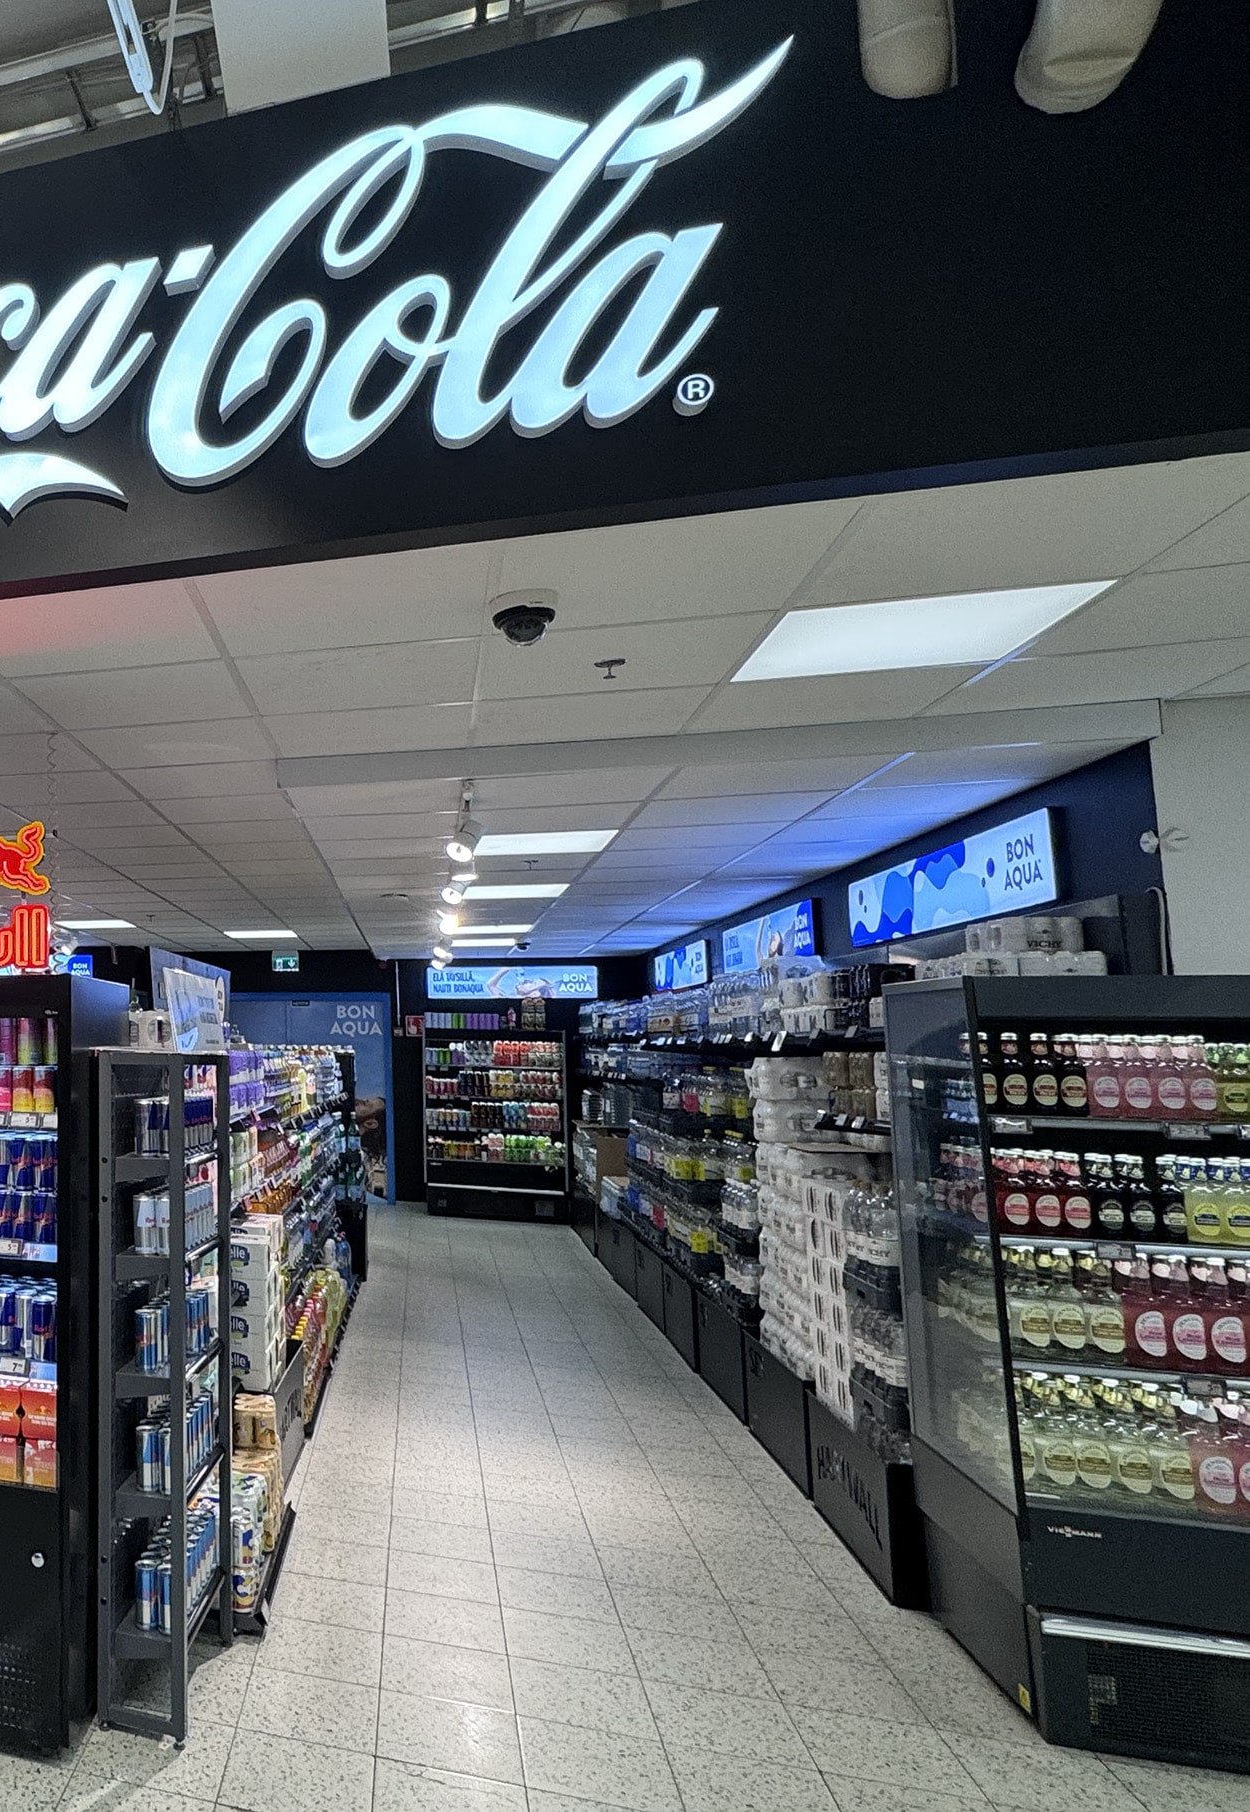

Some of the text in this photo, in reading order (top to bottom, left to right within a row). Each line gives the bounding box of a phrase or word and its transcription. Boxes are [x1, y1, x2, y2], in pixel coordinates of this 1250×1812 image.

[1006, 833, 1035, 862] BON
[1004, 861, 1043, 890] AQUA
[1026, 939, 1063, 949] VICHY
[562, 973, 588, 982] BON
[558, 983, 593, 992] AQUA
[336, 1005, 376, 1020] BON
[329, 1021, 383, 1038] AQUA
